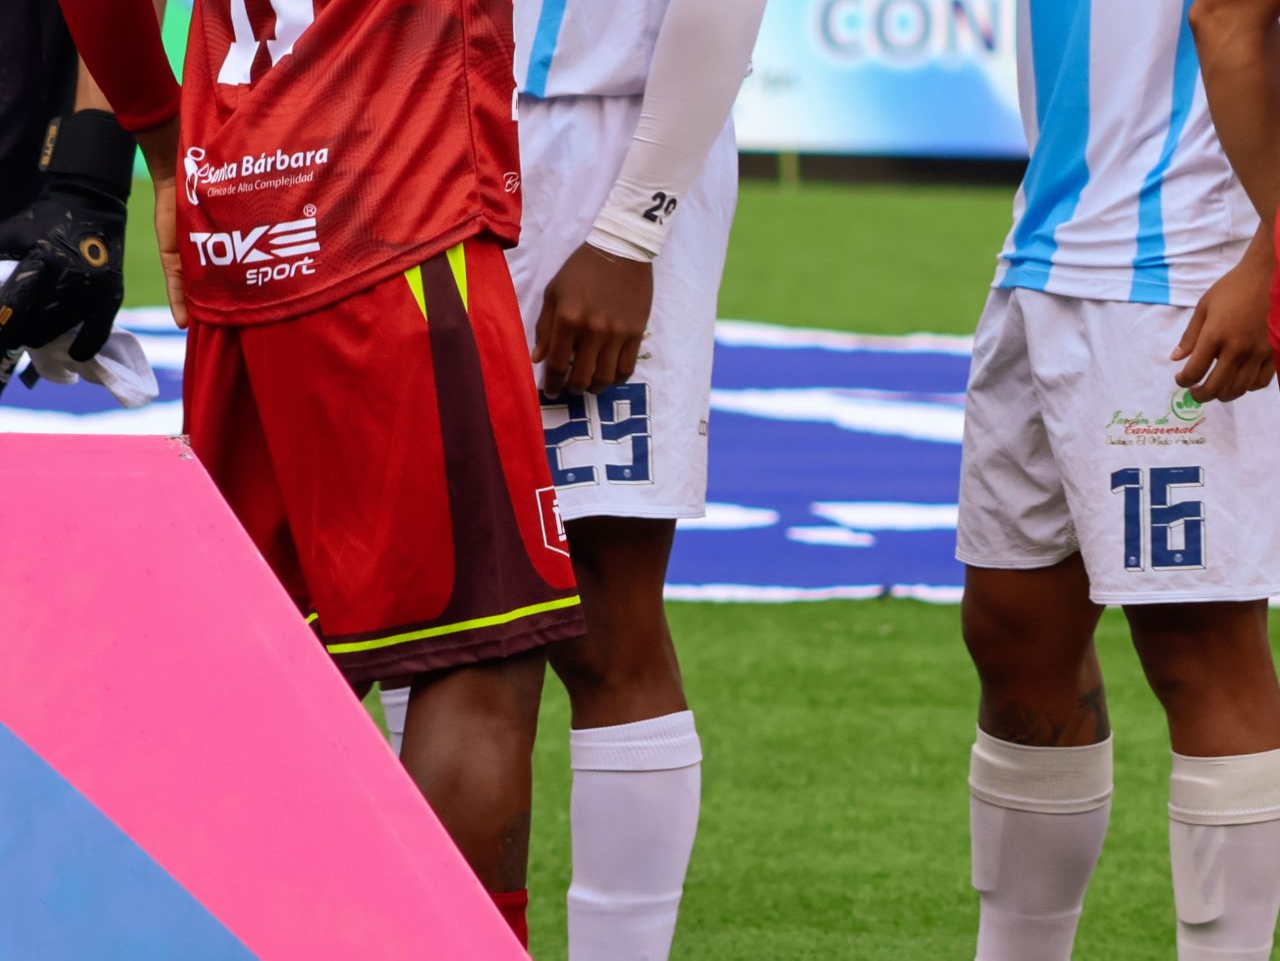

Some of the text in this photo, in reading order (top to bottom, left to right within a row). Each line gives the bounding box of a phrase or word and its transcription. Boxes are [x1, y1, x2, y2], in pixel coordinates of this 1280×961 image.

[241, 148, 329, 177] Bárbara
[246, 256, 316, 286] sport
[1110, 466, 1207, 572] 16
